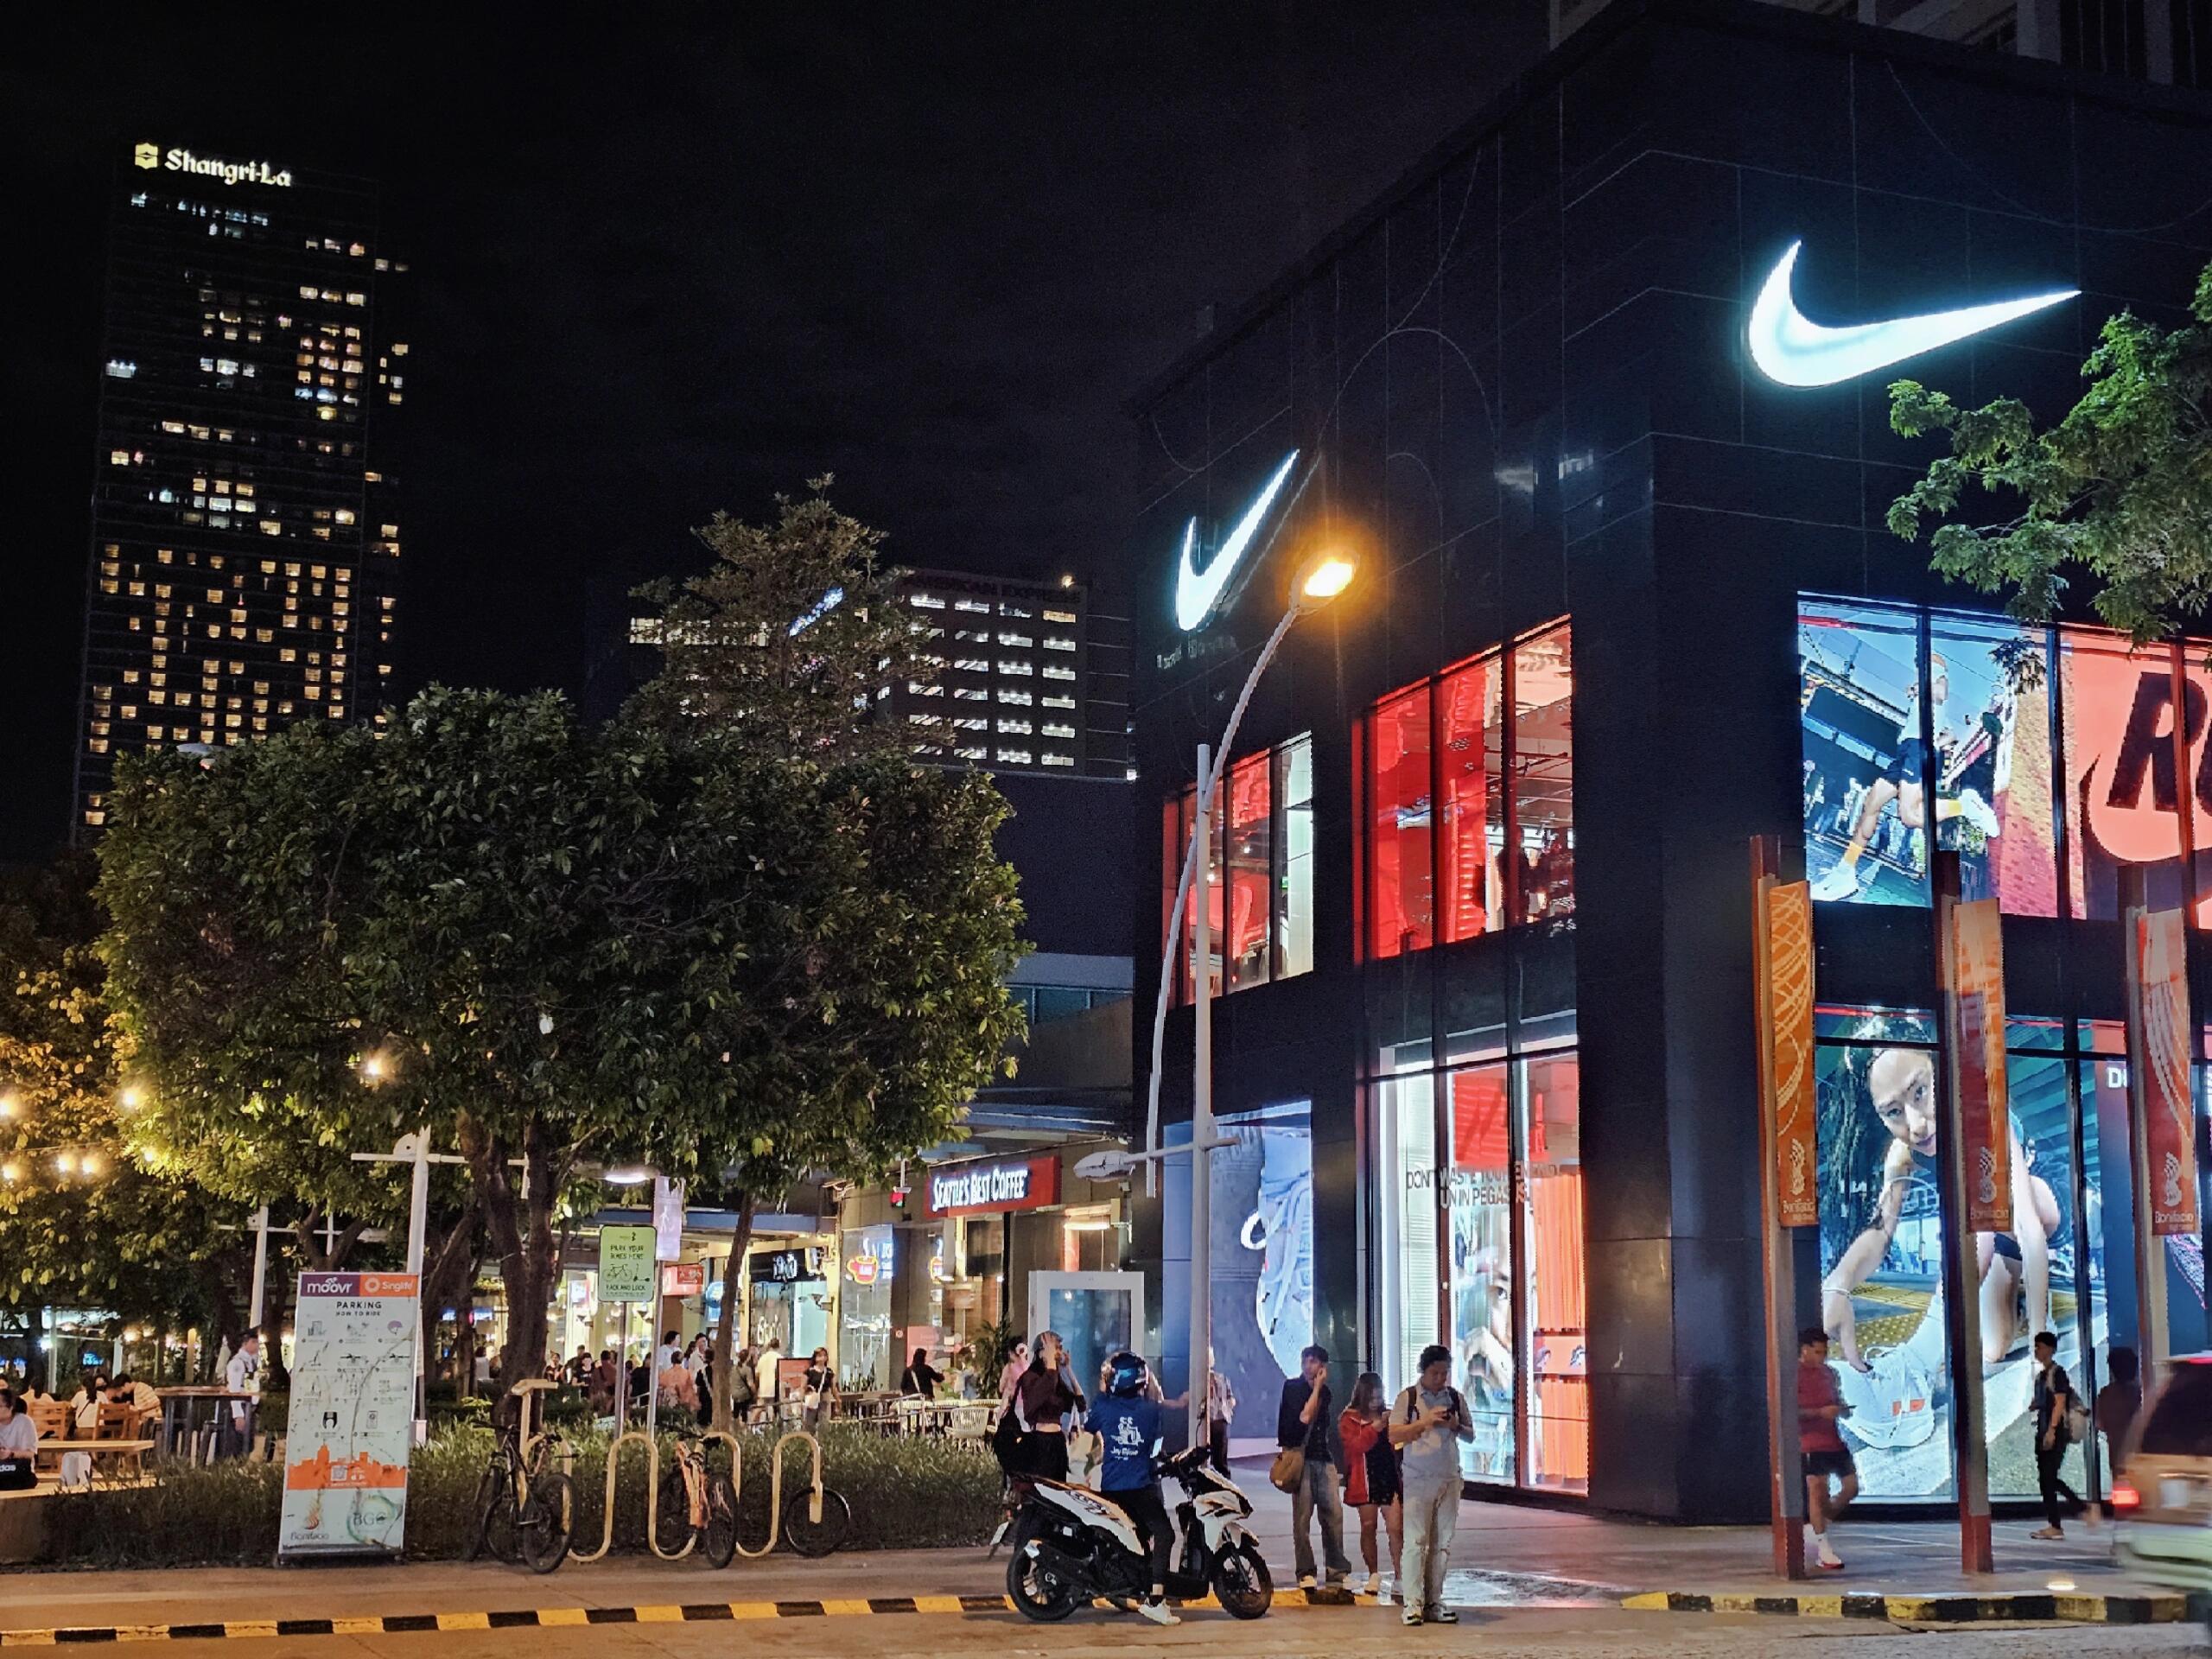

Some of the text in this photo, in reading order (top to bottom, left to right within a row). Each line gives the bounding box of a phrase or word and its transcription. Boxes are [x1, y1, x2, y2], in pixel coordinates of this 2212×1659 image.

[164, 148, 292, 187] Shangri-La
[969, 1173, 991, 1205] BEST
[991, 1167, 1027, 1201] COFFEE
[307, 1283, 353, 1294] moovr
